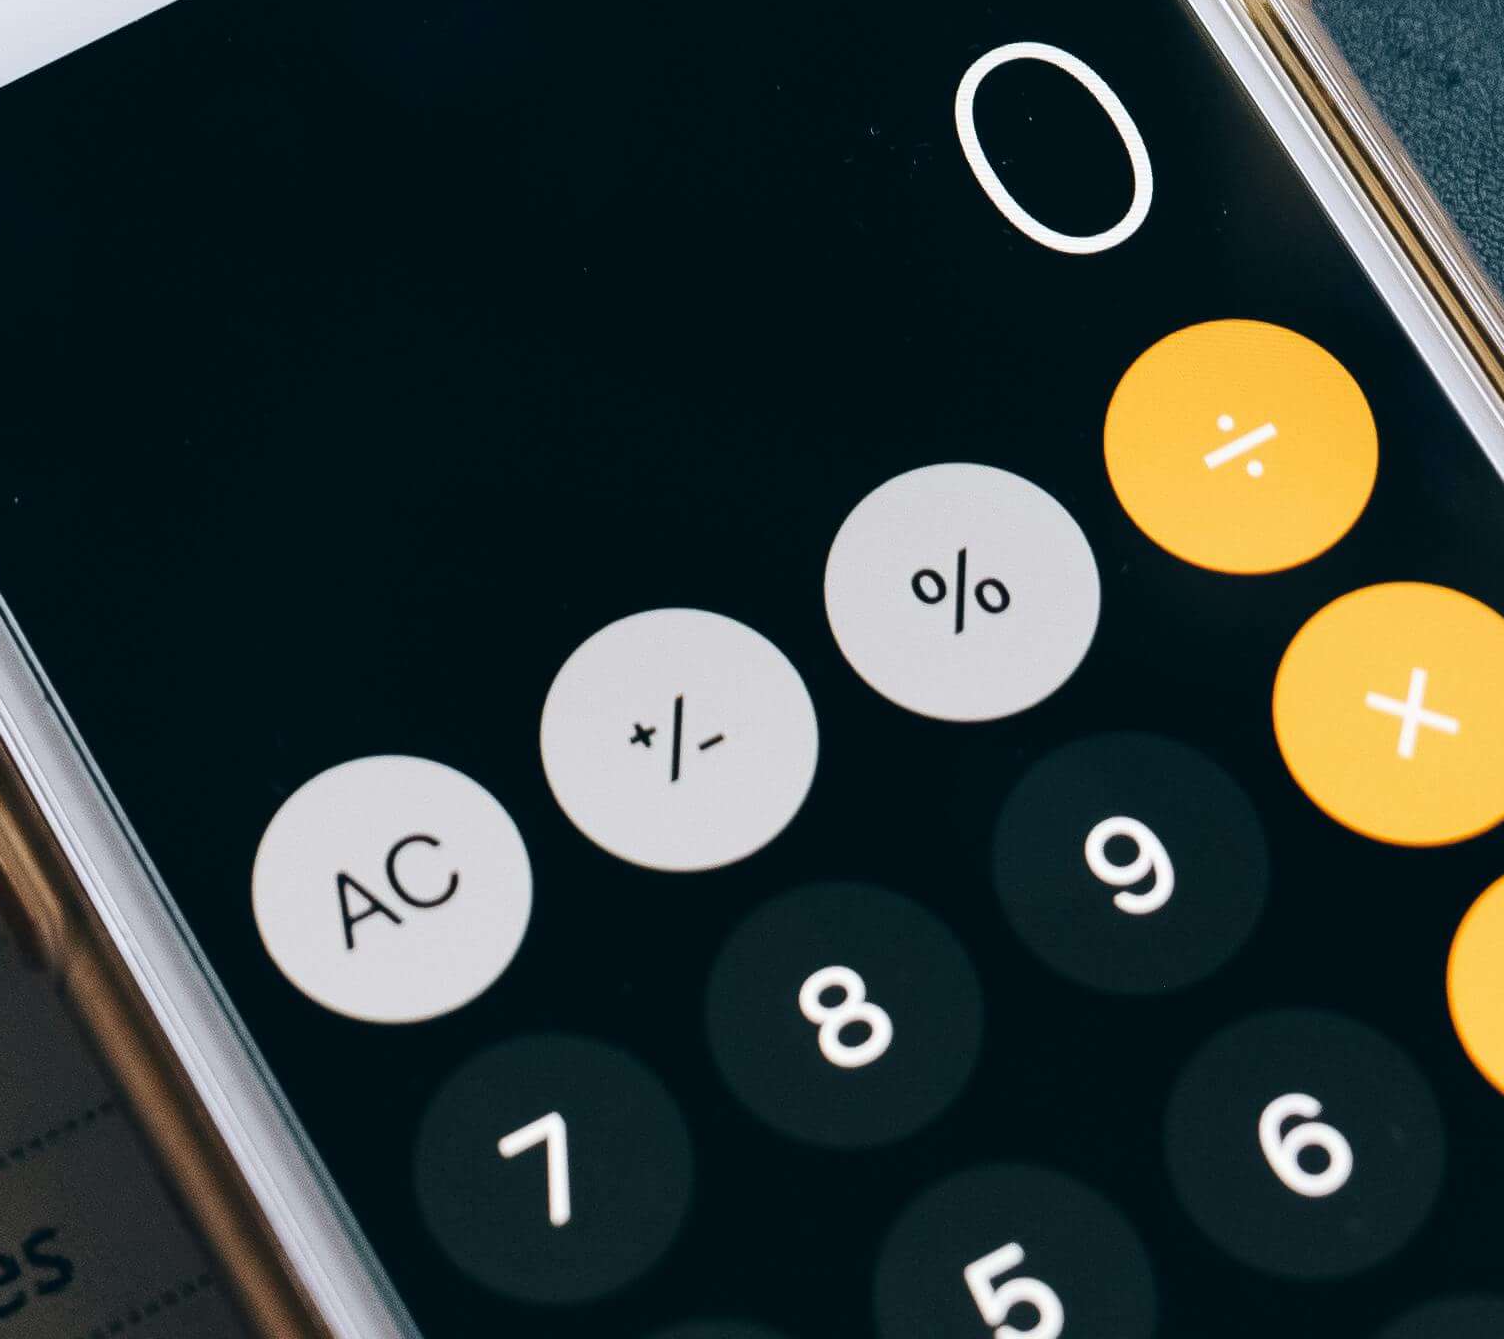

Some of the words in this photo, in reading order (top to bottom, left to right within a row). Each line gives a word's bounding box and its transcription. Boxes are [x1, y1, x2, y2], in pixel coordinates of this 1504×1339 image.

[952, 39, 1156, 257] 0
[335, 833, 460, 951] AC
[910, 547, 1012, 635] %
[497, 1111, 572, 1226] 7
[797, 964, 894, 1069] 8
[1083, 815, 1176, 915] 9
[963, 1241, 1065, 1339] 5
[1258, 1092, 1354, 1198] 6
